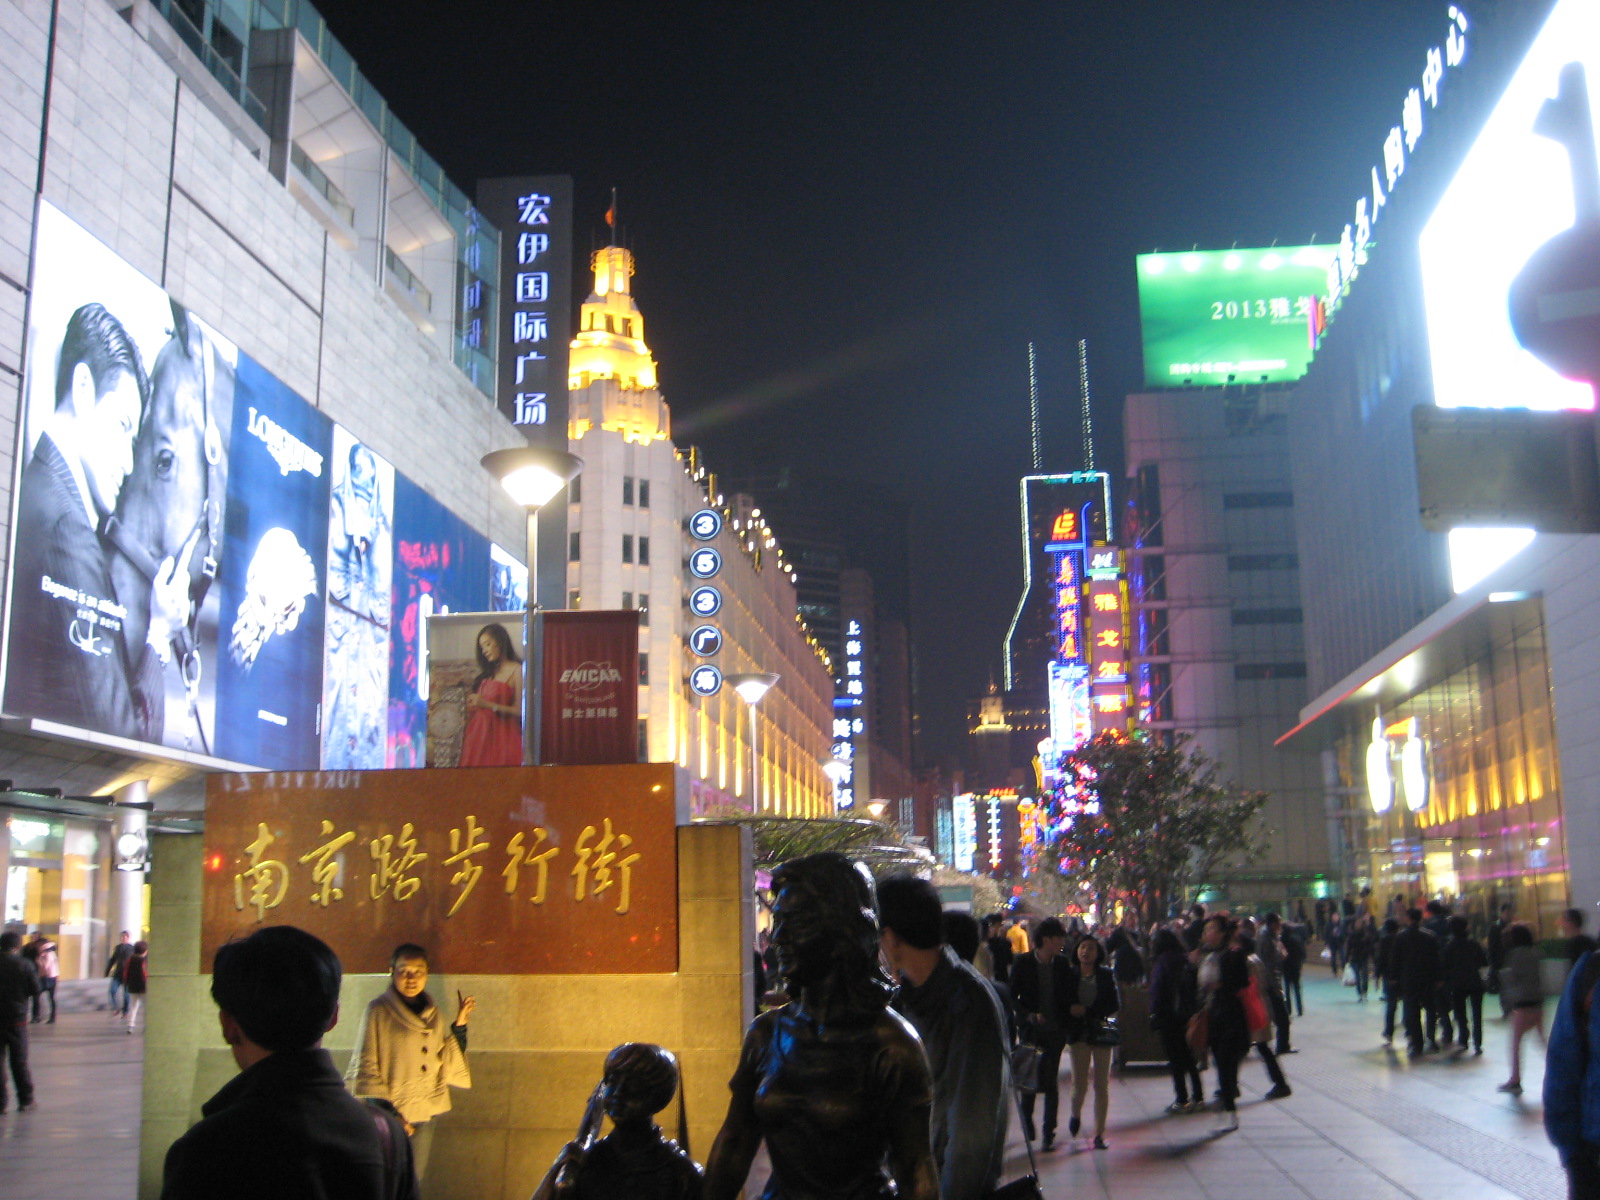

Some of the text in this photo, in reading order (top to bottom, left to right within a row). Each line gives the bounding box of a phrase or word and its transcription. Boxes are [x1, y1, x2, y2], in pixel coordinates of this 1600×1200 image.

[513, 193, 550, 426] 宏伊国际广场
[559, 668, 621, 683] ENICAR
[233, 816, 641, 922] 南京路步行街
